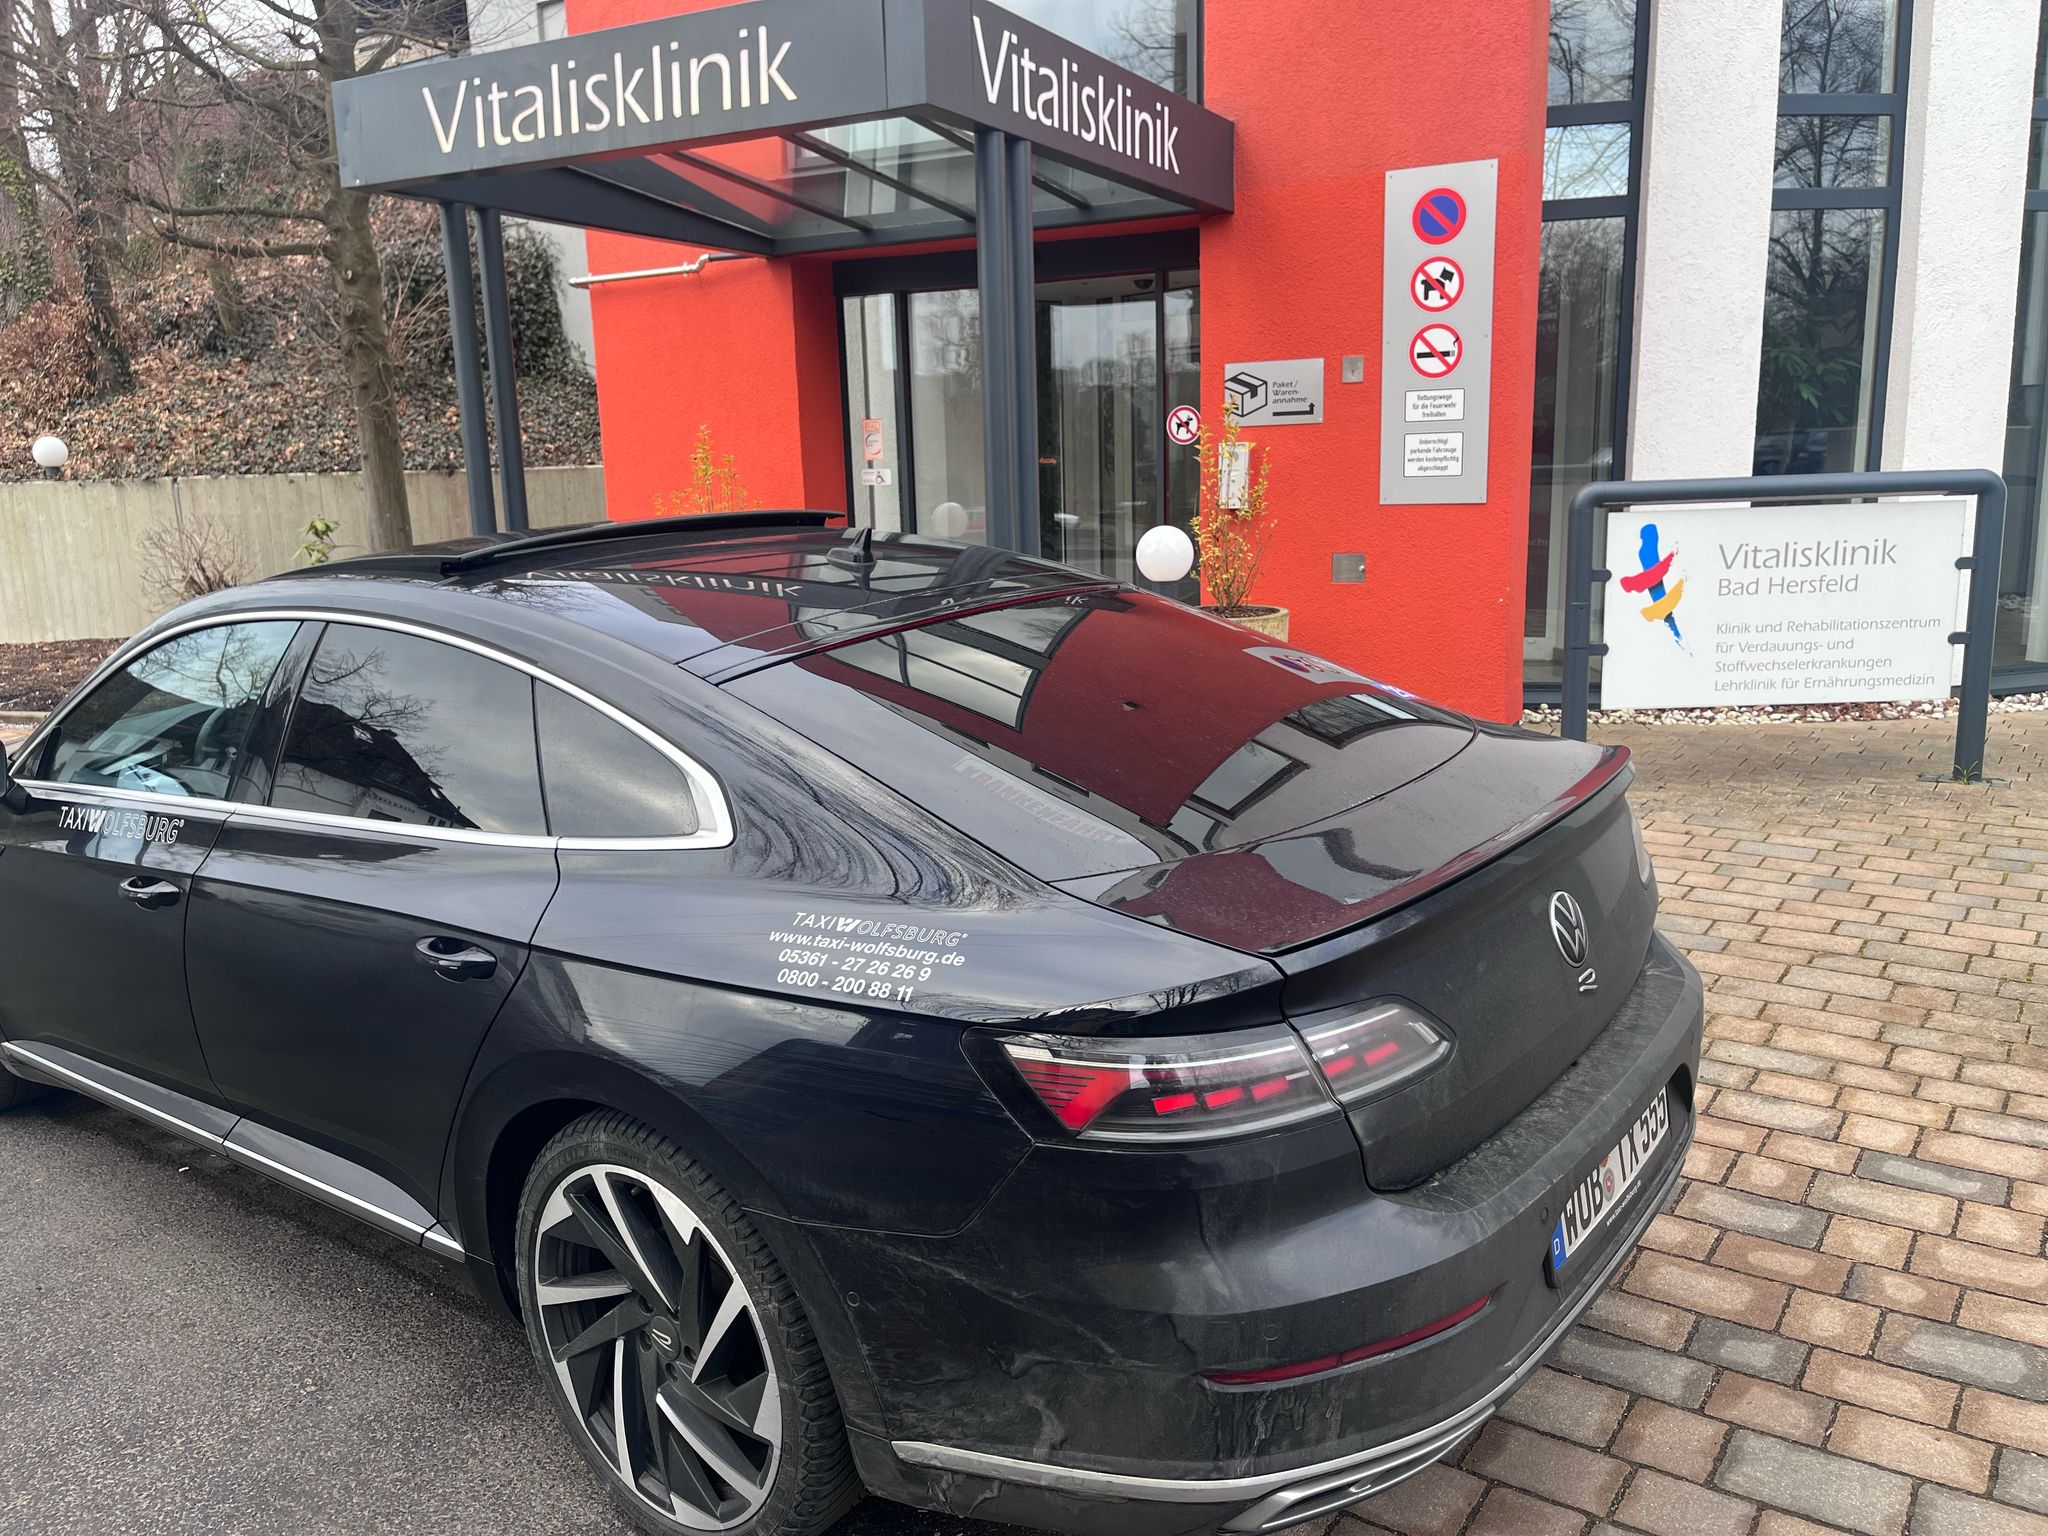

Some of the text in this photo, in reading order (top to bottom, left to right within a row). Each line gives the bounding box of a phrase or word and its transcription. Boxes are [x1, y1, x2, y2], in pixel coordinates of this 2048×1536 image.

[421, 25, 798, 155] Vitalisklinik
[972, 14, 1181, 176] Vitalisklinik
[1410, 446, 1456, 455] parkende Fahrzeuge
[1418, 464, 1448, 472] abgeschleppt
[1718, 538, 1898, 571] Vitalisklinik
[1717, 573, 1860, 598] Bad Hersfeld
[1716, 615, 1942, 636] Klinik und Rehabilitationszentrum
[1715, 637, 1855, 655] für Verdauungs- und
[1714, 655, 1893, 674] Stoffwechselerkrankungen
[1714, 672, 1935, 692] Lehrklinik für Ernährungsmedizin
[768, 928, 967, 968] www.taxi-wolfsburg.de
[778, 947, 829, 968] 05361
[840, 957, 864, 973] 27
[866, 960, 890, 977] 26
[890, 963, 915, 980] 26
[918, 966, 932, 983] 9
[776, 967, 817, 988] 0800
[831, 975, 867, 996] 200
[867, 980, 891, 998] 88
[896, 984, 914, 1003] 11
[1553, 1237, 1561, 1256] D
